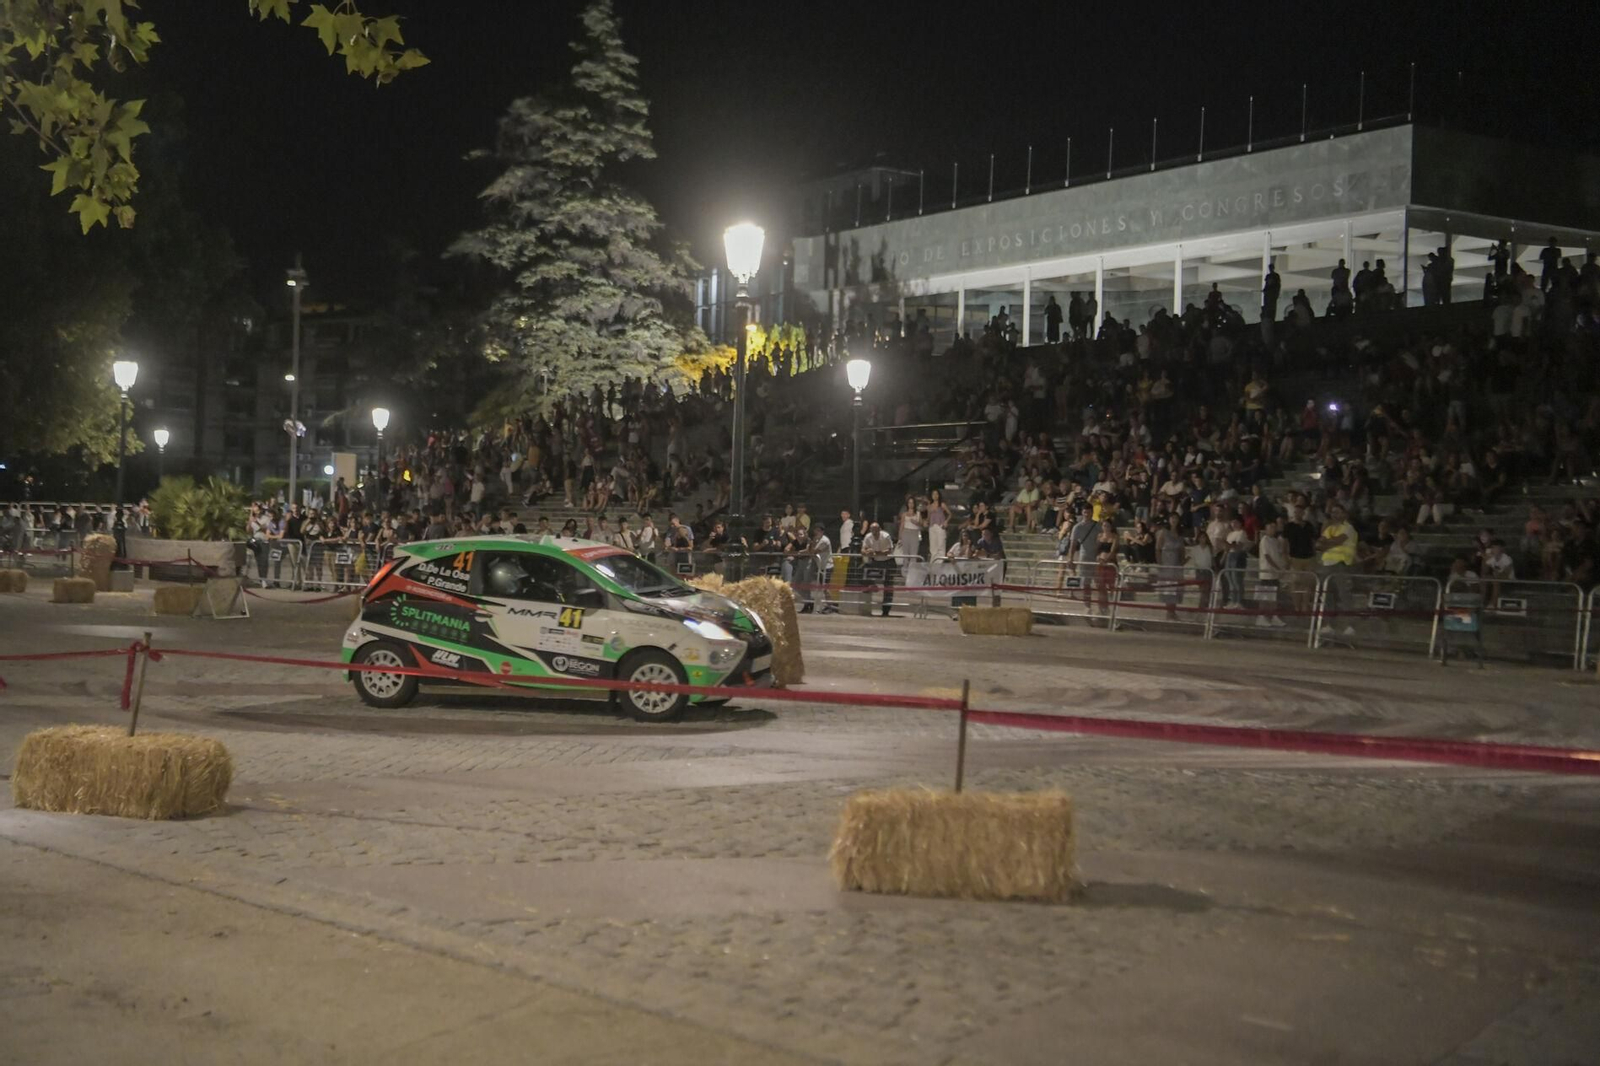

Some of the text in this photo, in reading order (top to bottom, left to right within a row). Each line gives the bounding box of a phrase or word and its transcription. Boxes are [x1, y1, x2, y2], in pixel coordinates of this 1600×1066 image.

[924, 246, 945, 262] DE
[961, 215, 1127, 257] EXPOSICIONES
[1182, 179, 1344, 222] CONGRESOS
[453, 551, 474, 572] 41
[440, 567, 452, 577] La
[452, 569, 471, 581] Osa
[401, 606, 470, 631] SPLITMANIA
[507, 607, 558, 620] MMR
[560, 607, 582, 629] 41
